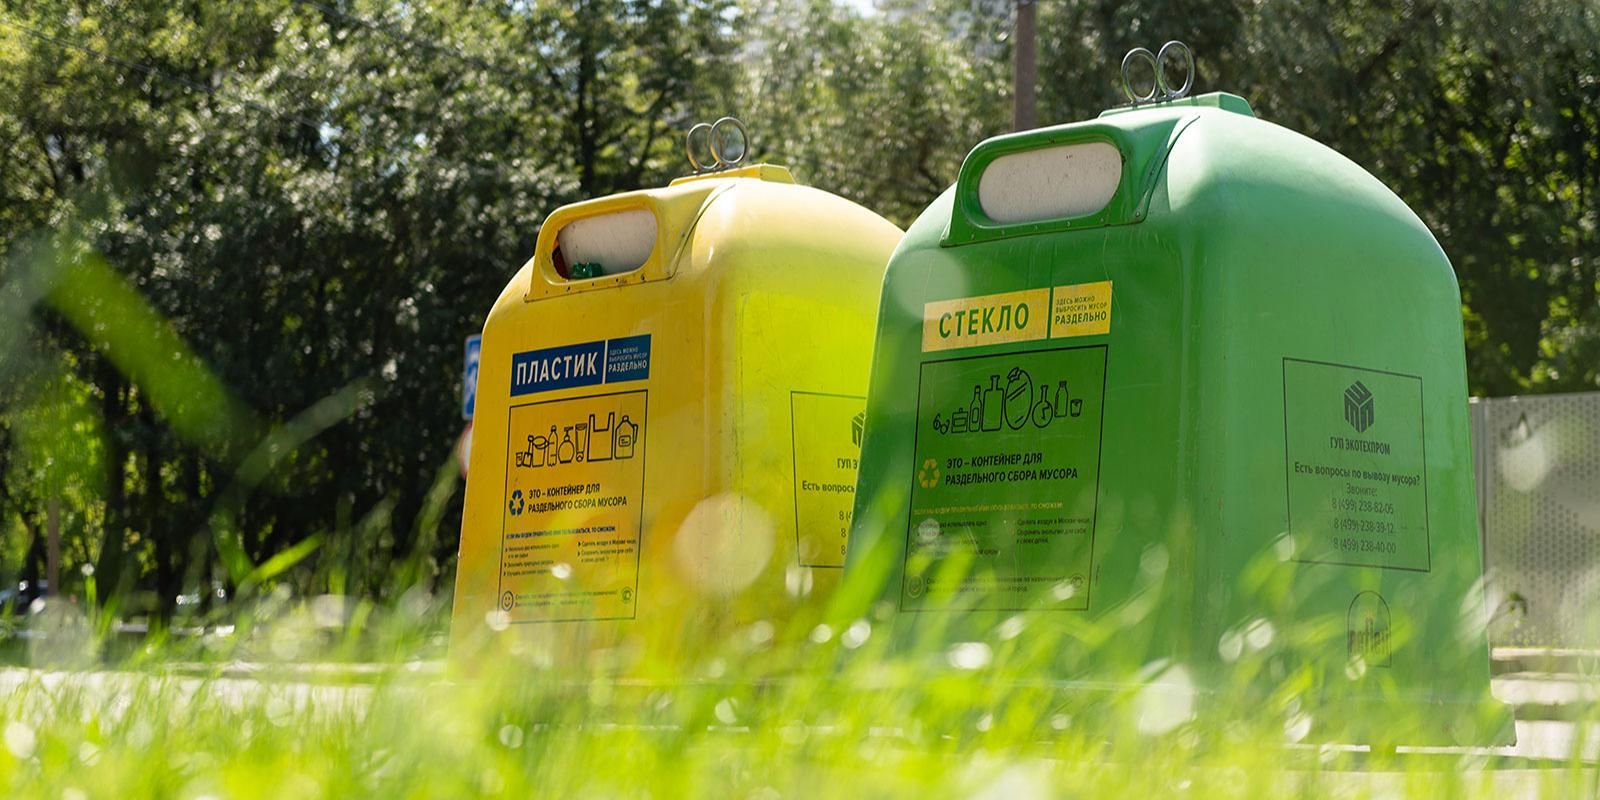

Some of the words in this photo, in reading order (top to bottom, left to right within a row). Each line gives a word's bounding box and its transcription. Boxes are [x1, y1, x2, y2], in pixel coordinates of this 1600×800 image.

[1056, 297, 1073, 305] ЗДЕСЬ
[1074, 295, 1095, 303] МОЖНО
[1056, 304, 1087, 313] ВЫБРОСИТЬ
[1088, 301, 1107, 309] МУСОР
[939, 302, 1029, 339] СТЕКЛО
[1055, 310, 1107, 325] РАЗДЕЛЬНО
[516, 351, 598, 386] ПЛАСТИК
[608, 359, 648, 373] РАЗДЕЛЬНО
[1330, 436, 1344, 449] ГУП
[1345, 437, 1391, 456] ЭКОТЕХПРОМ
[837, 458, 851, 470] ГУП
[946, 457, 963, 469] ЭТО
[971, 452, 1022, 468] КОНТЕЙНЕР
[1022, 452, 1042, 465] ДЛЯ
[945, 471, 1006, 486] РАЗДЕЛЬНОГО
[1007, 469, 1037, 482] СБОРА
[1039, 467, 1078, 480] МУСОРА
[1294, 461, 1314, 474] Есть
[1315, 464, 1350, 478] вопросы
[1351, 471, 1362, 479] по
[1363, 470, 1390, 485] вывозу
[1391, 474, 1421, 487] мусора?
[528, 488, 541, 500] ЭТО
[546, 484, 585, 498] КОНТЕЙНЕР
[585, 483, 600, 495] ДЛЯ
[802, 479, 820, 492] Есть
[528, 501, 573, 514] РАЗДЕЛЬНОГО
[573, 498, 597, 510] СБОРА
[597, 496, 627, 507] МУСОРА
[1331, 497, 1337, 509] 8
[839, 510, 845, 521] 8
[1333, 517, 1339, 530] 8
[841, 527, 847, 539] 8
[841, 544, 847, 556] 8
[1333, 537, 1339, 550] 8
